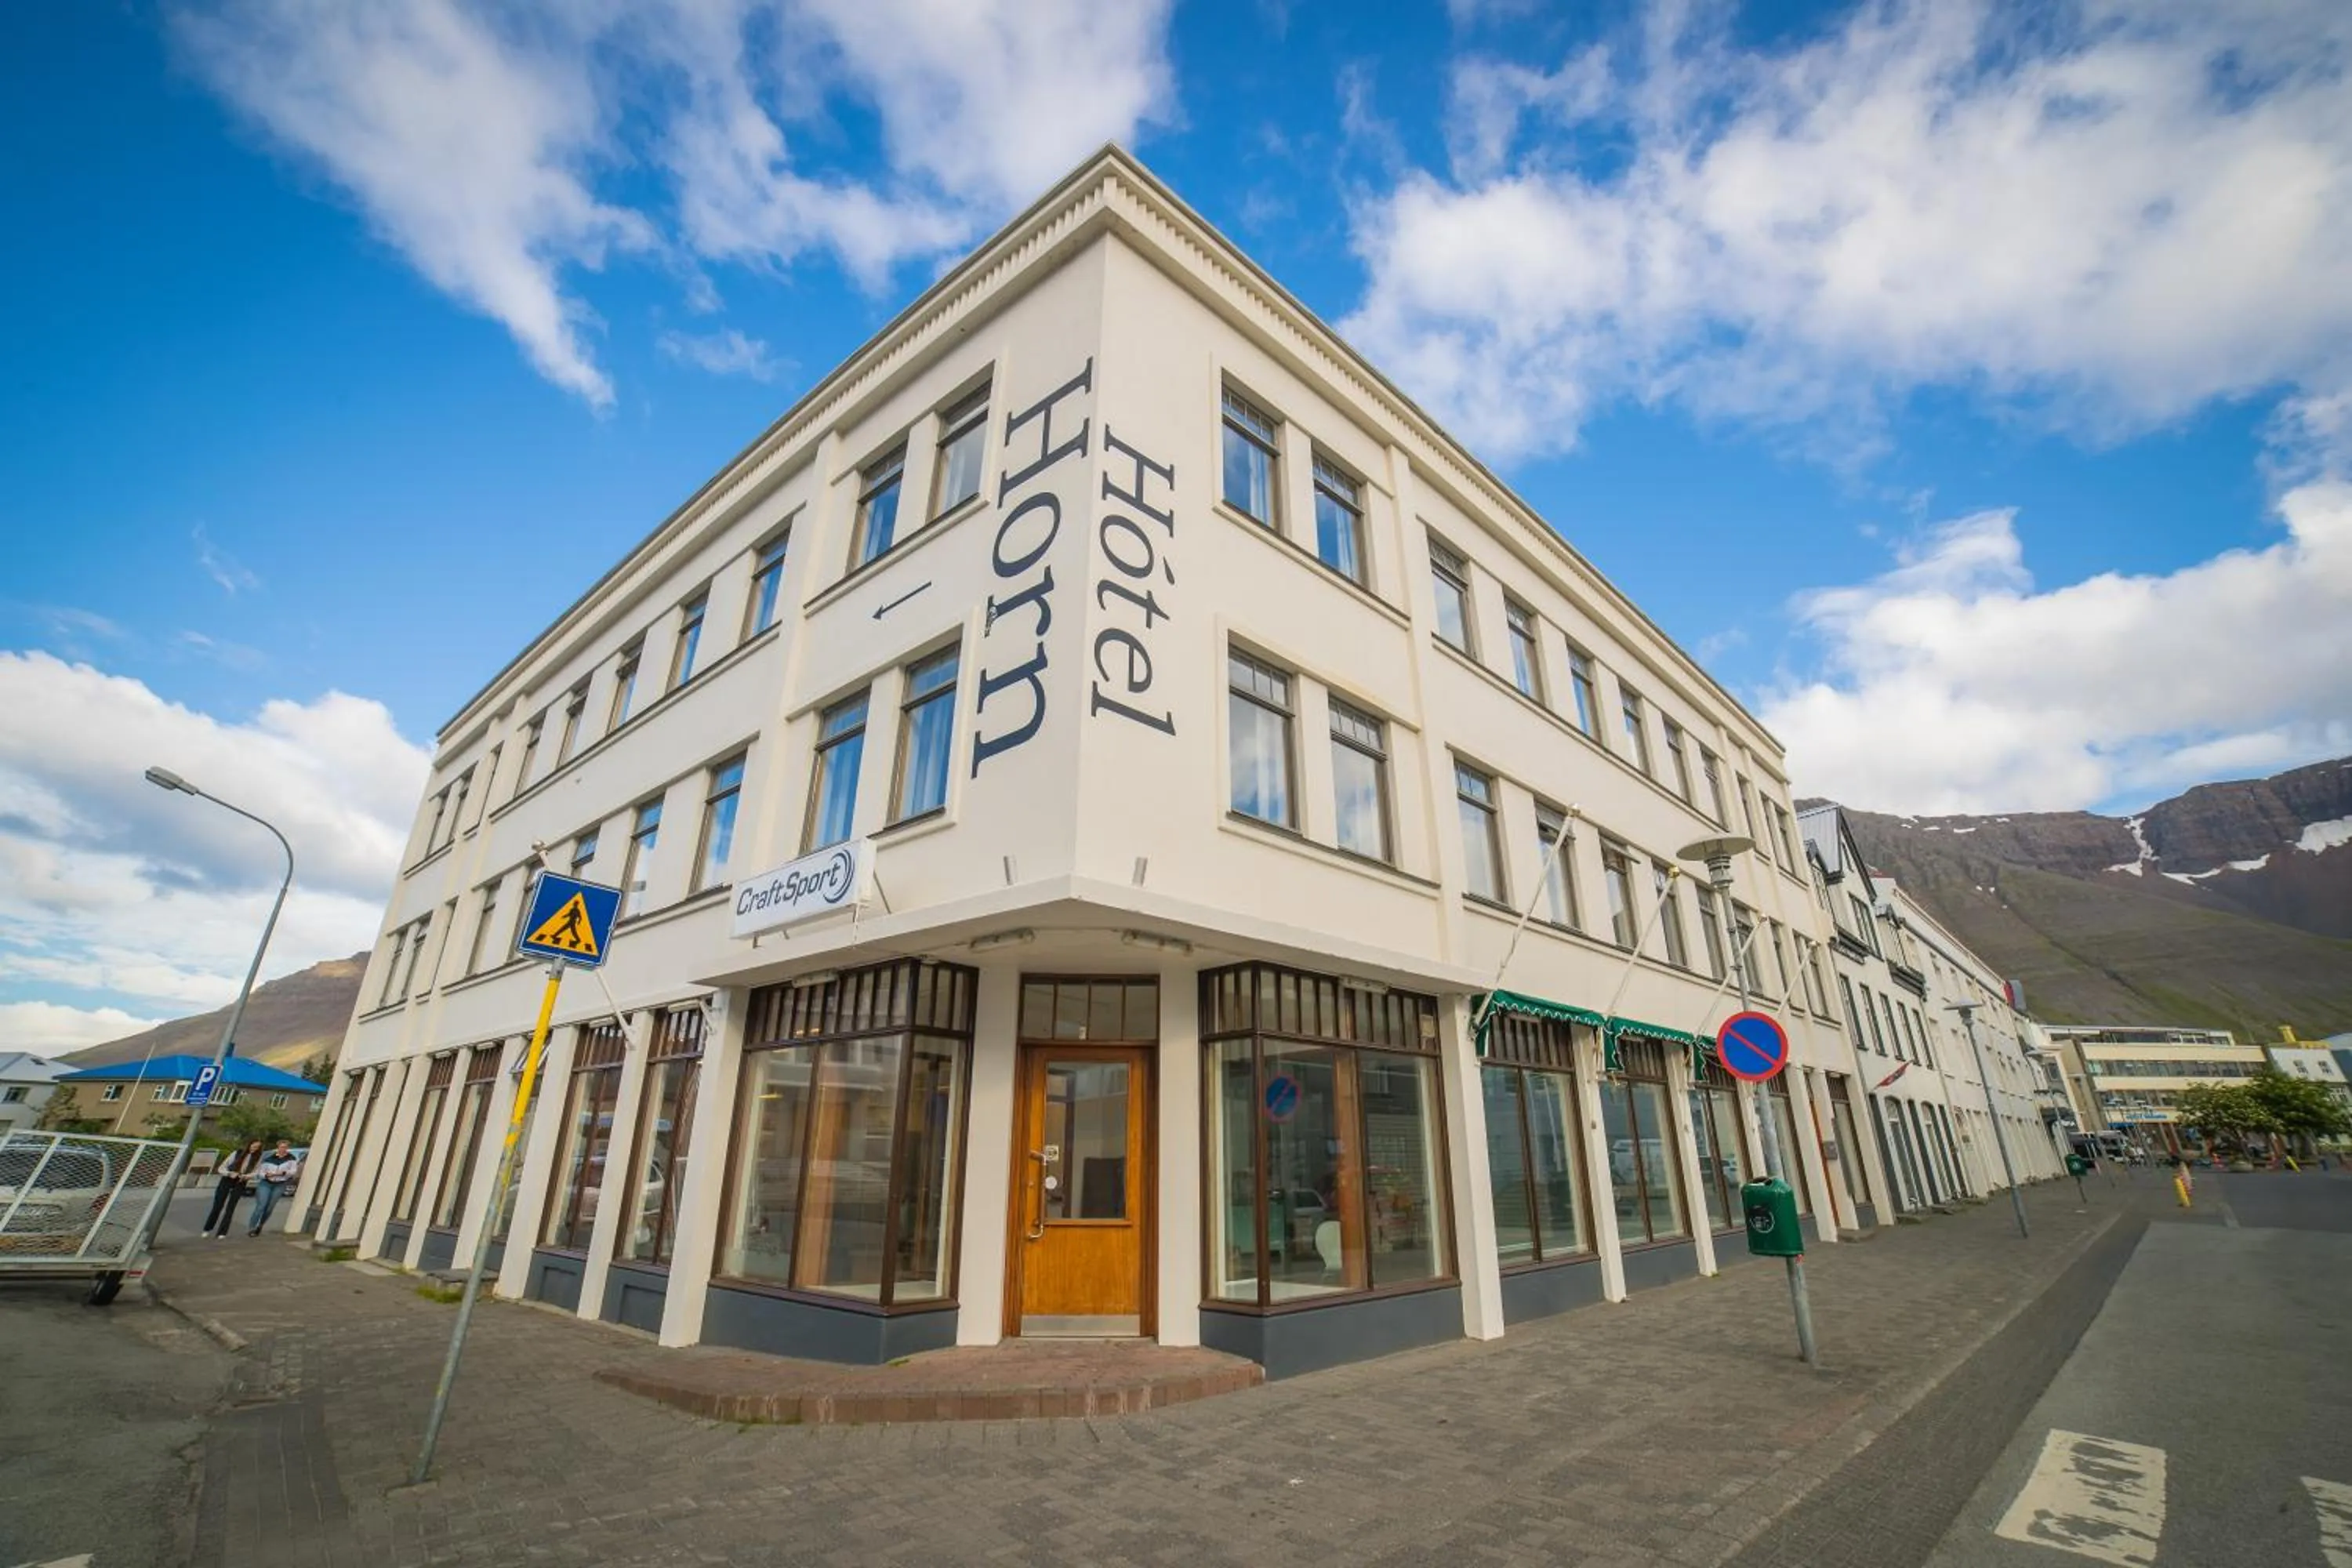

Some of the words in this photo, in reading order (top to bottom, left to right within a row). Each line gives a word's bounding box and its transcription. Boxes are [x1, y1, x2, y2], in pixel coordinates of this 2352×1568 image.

[971, 355, 1094, 779] Horn
[1091, 423, 1176, 736] Hótel
[195, 1067, 216, 1090] P
